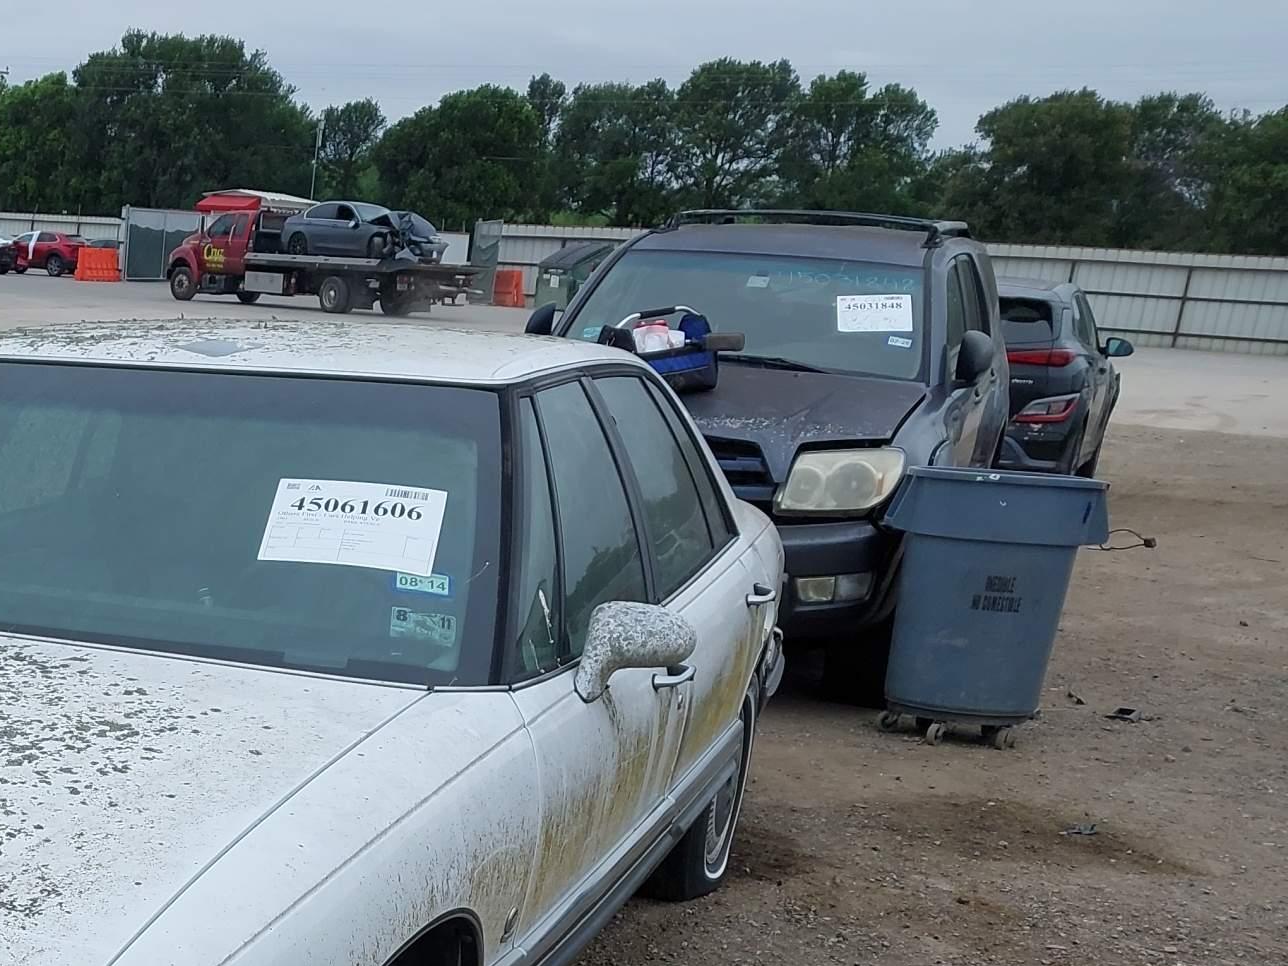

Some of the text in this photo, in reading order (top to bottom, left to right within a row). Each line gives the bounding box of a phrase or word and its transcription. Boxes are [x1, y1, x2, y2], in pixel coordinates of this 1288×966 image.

[844, 302, 903, 310] 45031848
[290, 496, 425, 521] 45061606
[399, 576, 446, 592] 08 14
[396, 609, 408, 622] 8
[440, 615, 452, 630] 11
